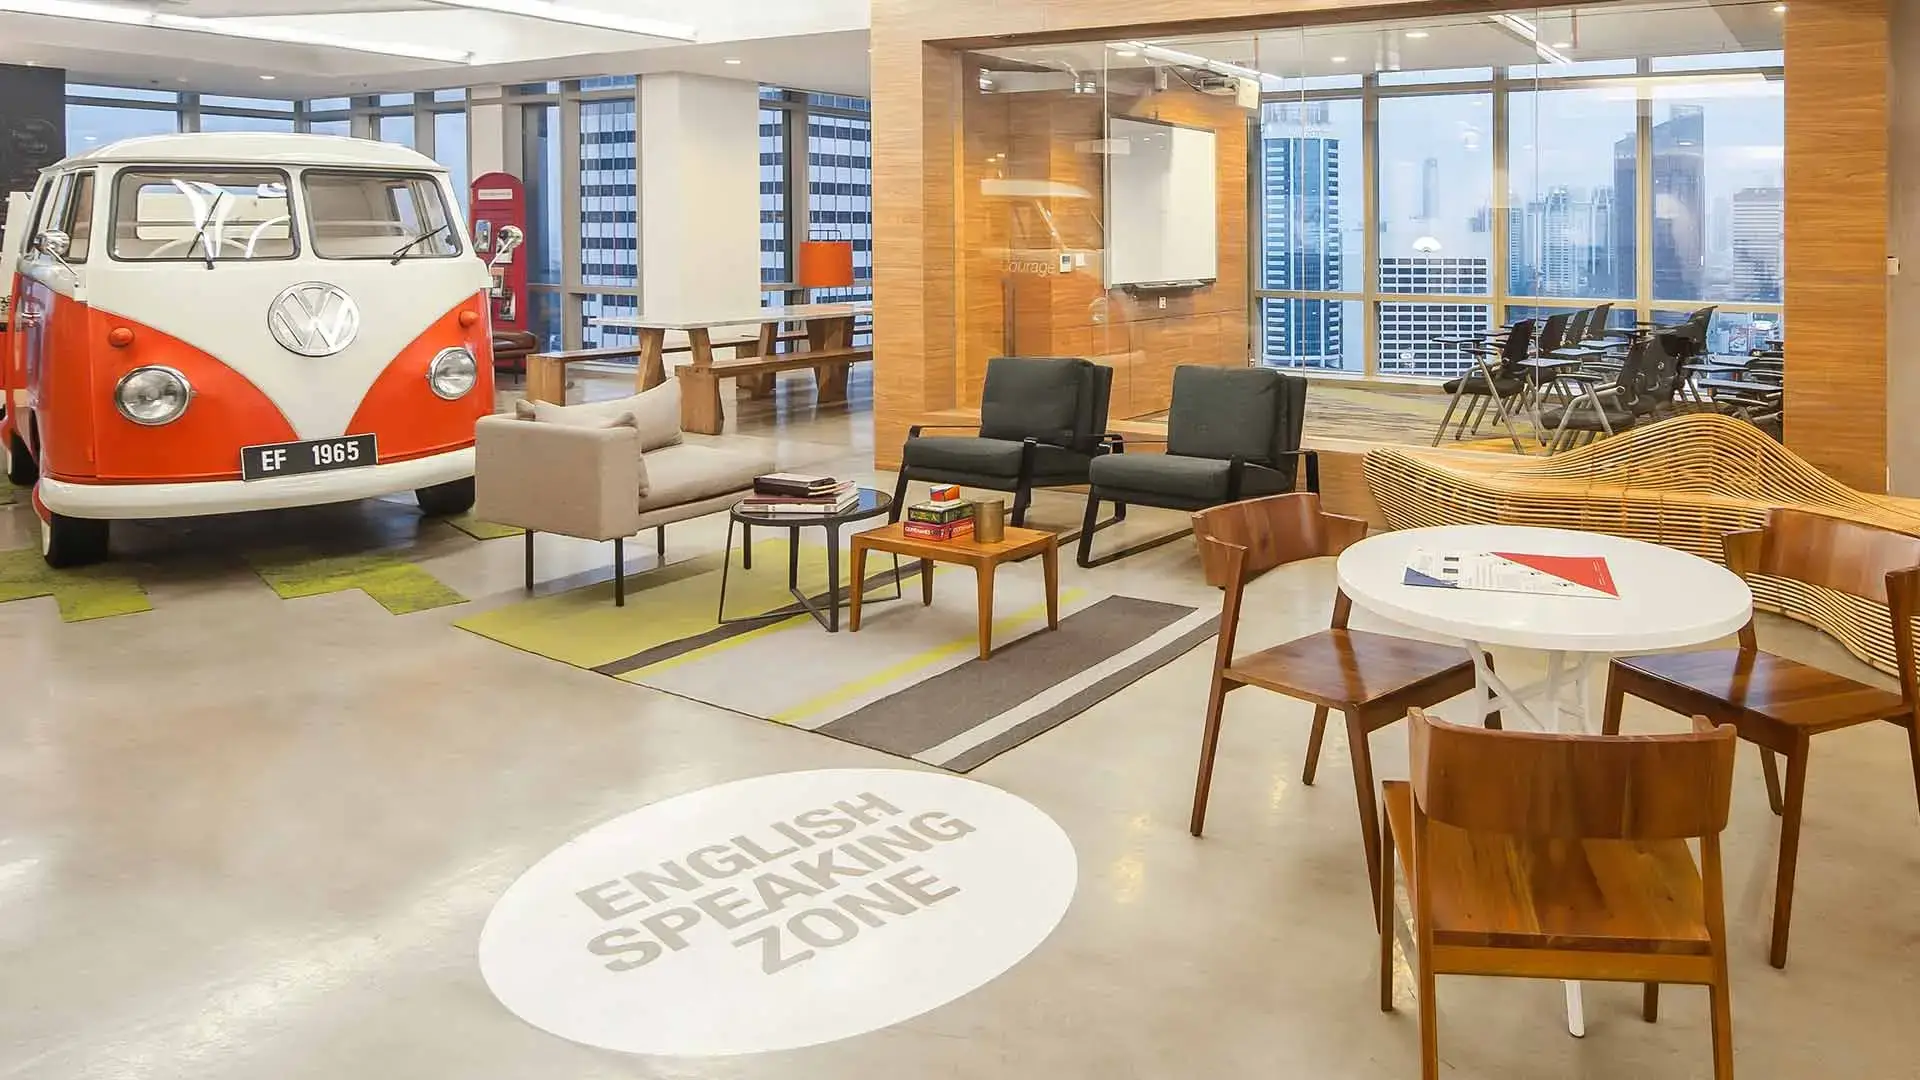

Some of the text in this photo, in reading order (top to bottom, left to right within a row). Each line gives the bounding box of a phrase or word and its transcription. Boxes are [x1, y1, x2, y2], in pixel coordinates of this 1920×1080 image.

[1003, 261, 1057, 278] ourage
[270, 283, 357, 356] VW
[261, 441, 359, 471] EF 1965
[575, 792, 903, 920] ENGLISH
[586, 811, 977, 972] SPEAKING
[731, 865, 961, 976] ZONE
